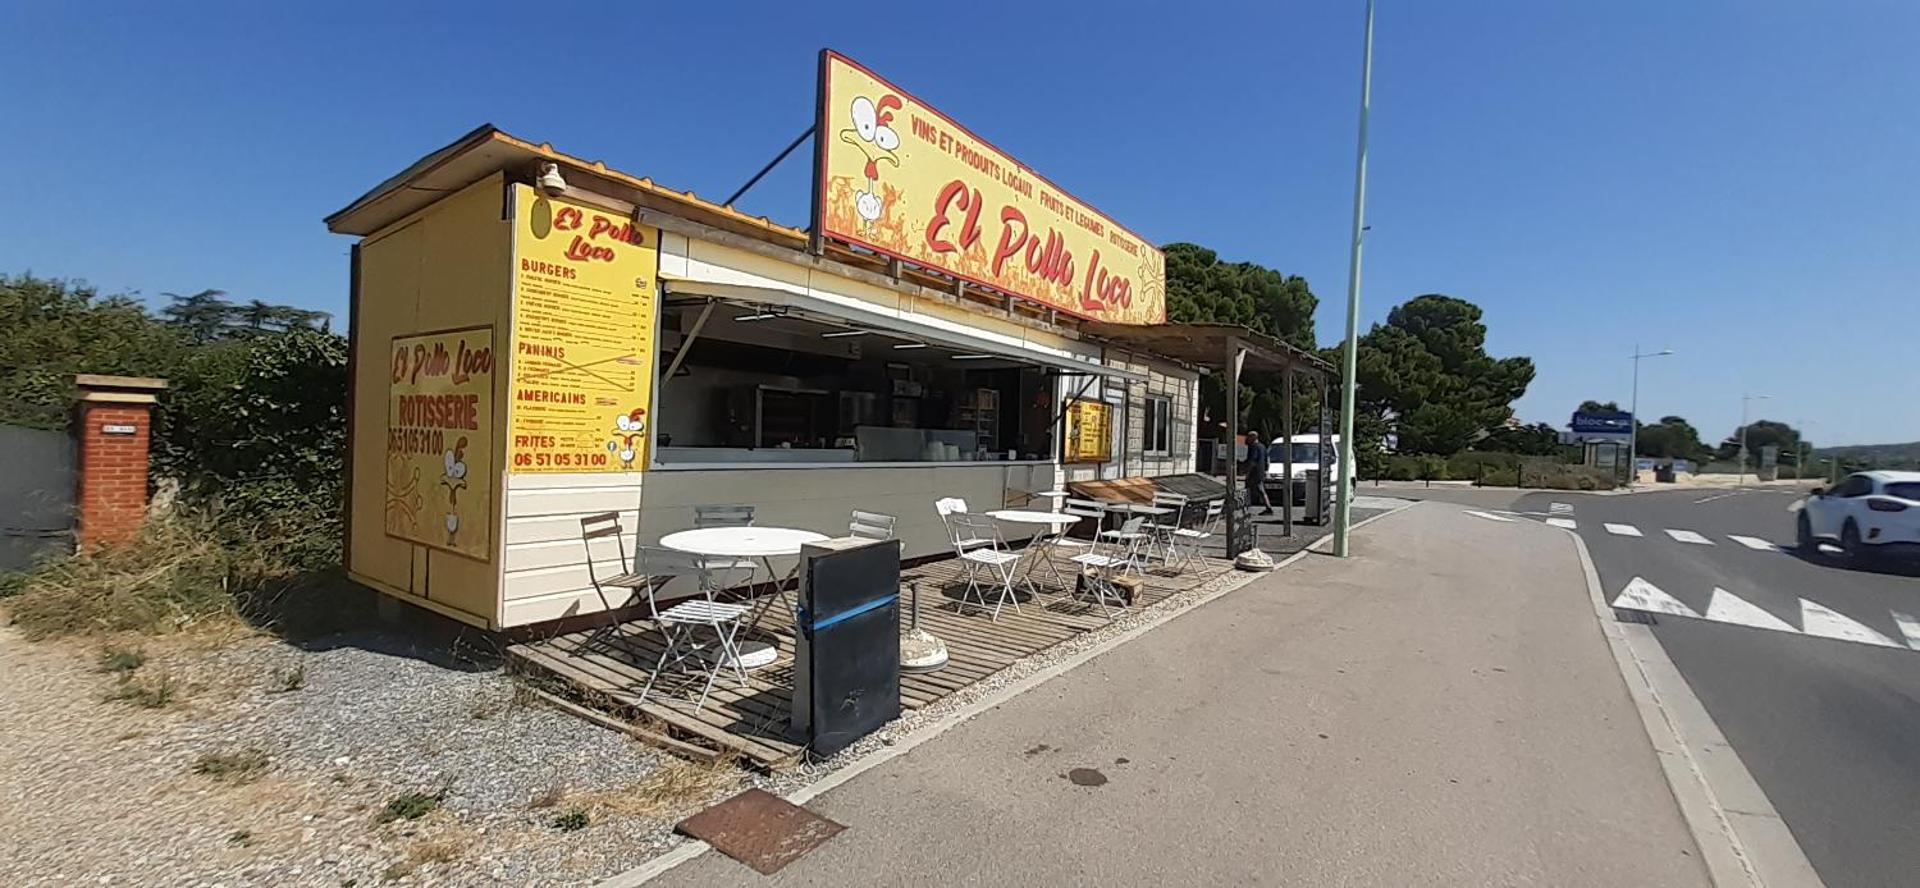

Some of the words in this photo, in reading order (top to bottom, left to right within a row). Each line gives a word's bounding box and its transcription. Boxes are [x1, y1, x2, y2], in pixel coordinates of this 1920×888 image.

[911, 113, 937, 145] VINS
[939, 130, 954, 154] ET
[955, 140, 1001, 181] PRODUITS
[1002, 167, 1033, 199] LOCAUX
[1040, 190, 1064, 217] FRUITS
[1065, 205, 1075, 222] ET
[552, 206, 584, 231] El
[588, 214, 644, 245] Pollo
[563, 234, 615, 262] Loco
[926, 179, 983, 253] El
[991, 205, 1075, 288] Pollo
[1079, 248, 1132, 311] Loco
[521, 258, 577, 280] BURGERS
[411, 343, 450, 385] Pollo
[452, 339, 492, 386] Loco
[518, 341, 565, 359] PANINIS
[516, 388, 586, 405] AMERICAINS
[399, 394, 479, 430] ROTISSERIE
[515, 435, 556, 448] FRITES
[514, 452, 532, 466] 06
[536, 453, 551, 467] 51
[554, 453, 570, 467] 05
[575, 453, 588, 467] 31
[591, 453, 607, 467] 00
